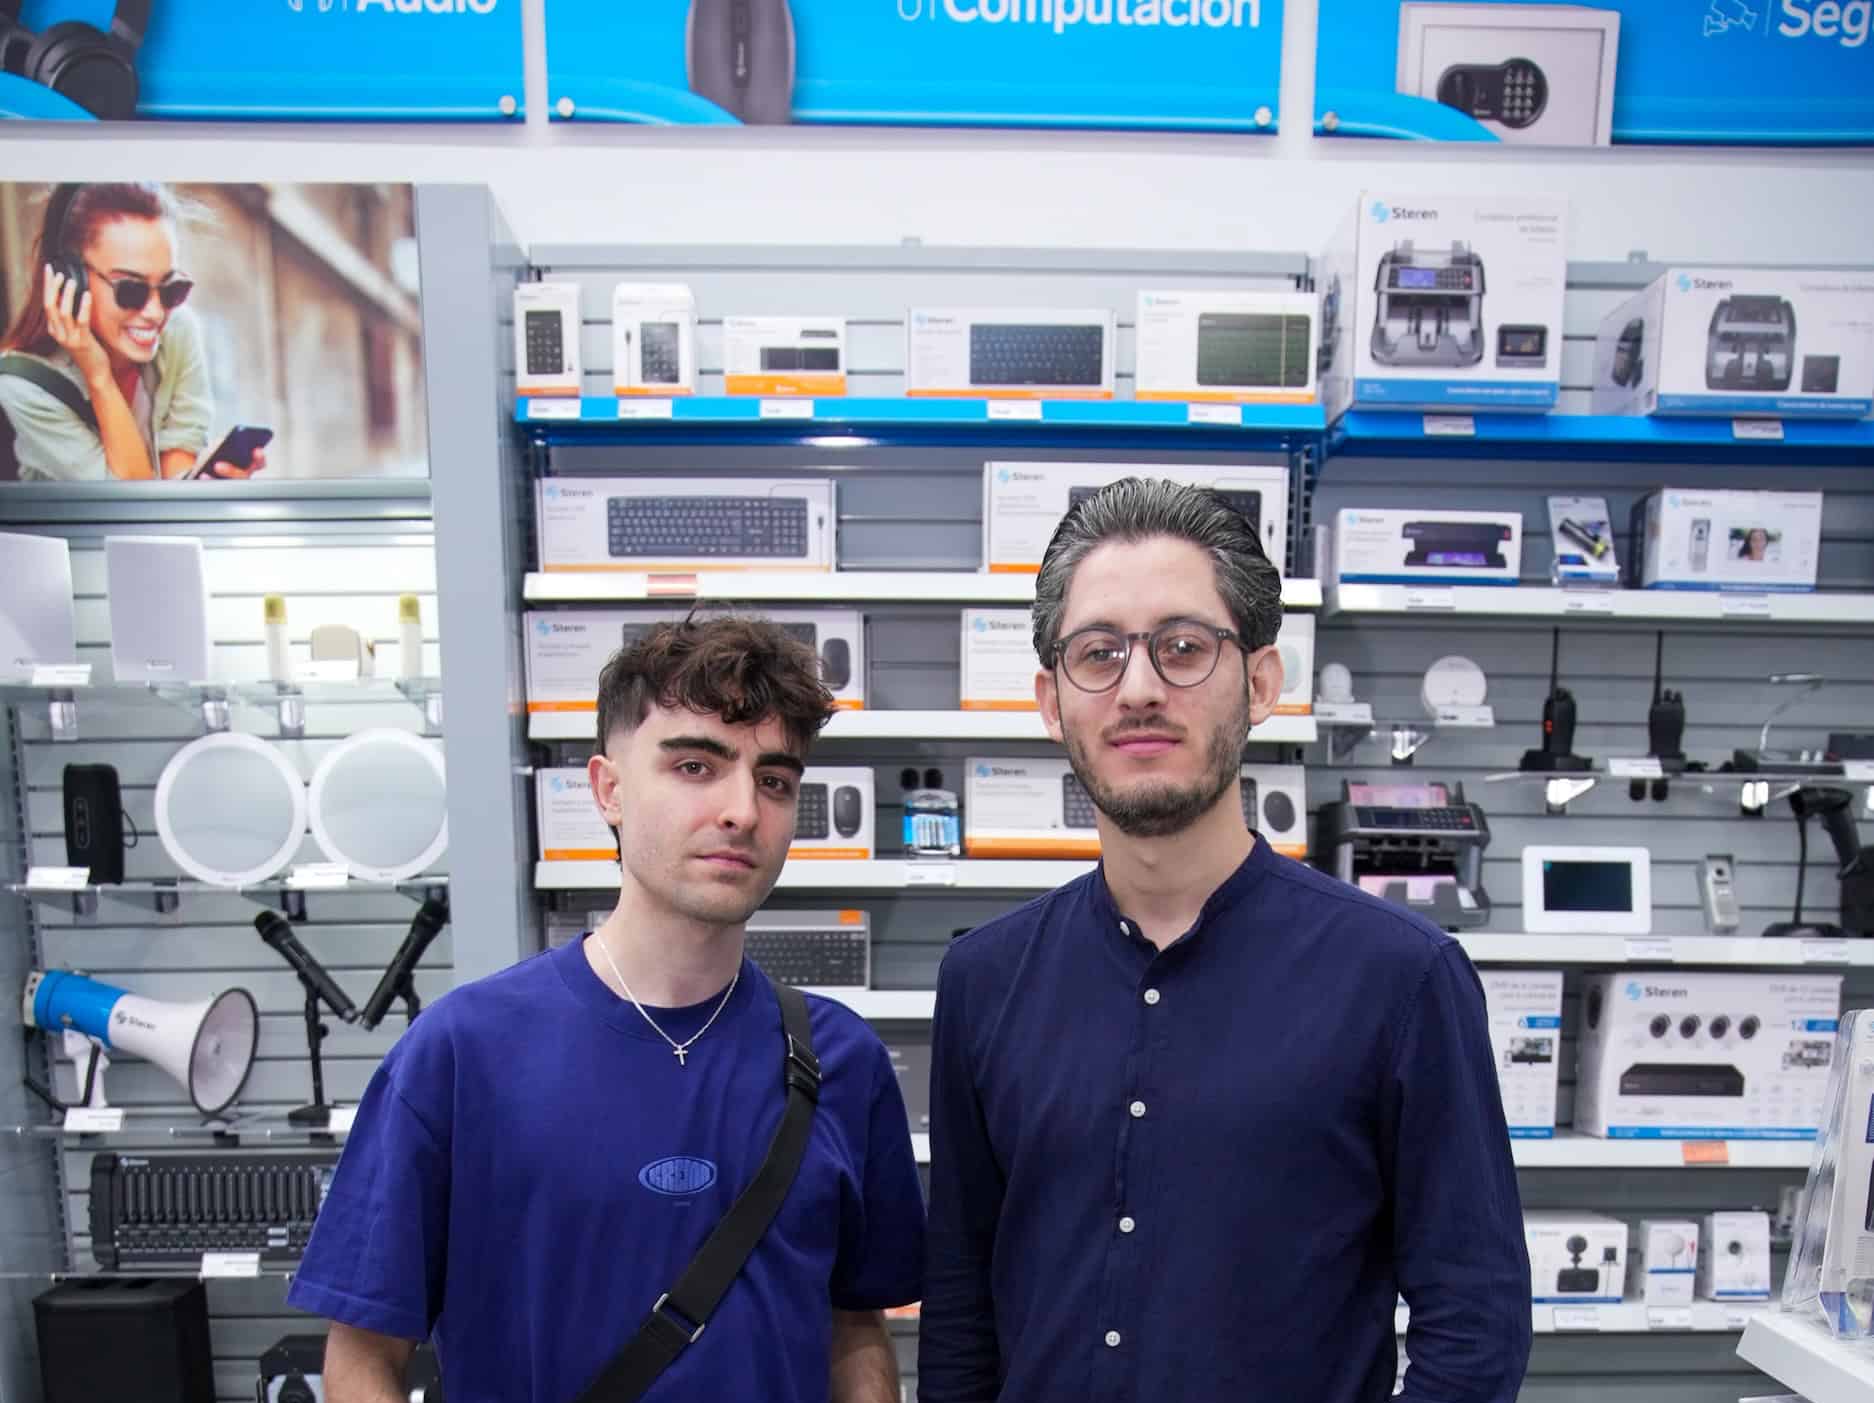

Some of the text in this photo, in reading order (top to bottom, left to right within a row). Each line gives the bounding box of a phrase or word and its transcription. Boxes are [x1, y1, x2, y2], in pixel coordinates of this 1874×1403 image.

[1778, 0, 1874, 47] Seg
[1391, 206, 1438, 220] Steren
[1694, 278, 1733, 290] Steren
[552, 623, 587, 633] Steren
[1645, 985, 1689, 999] Steren
